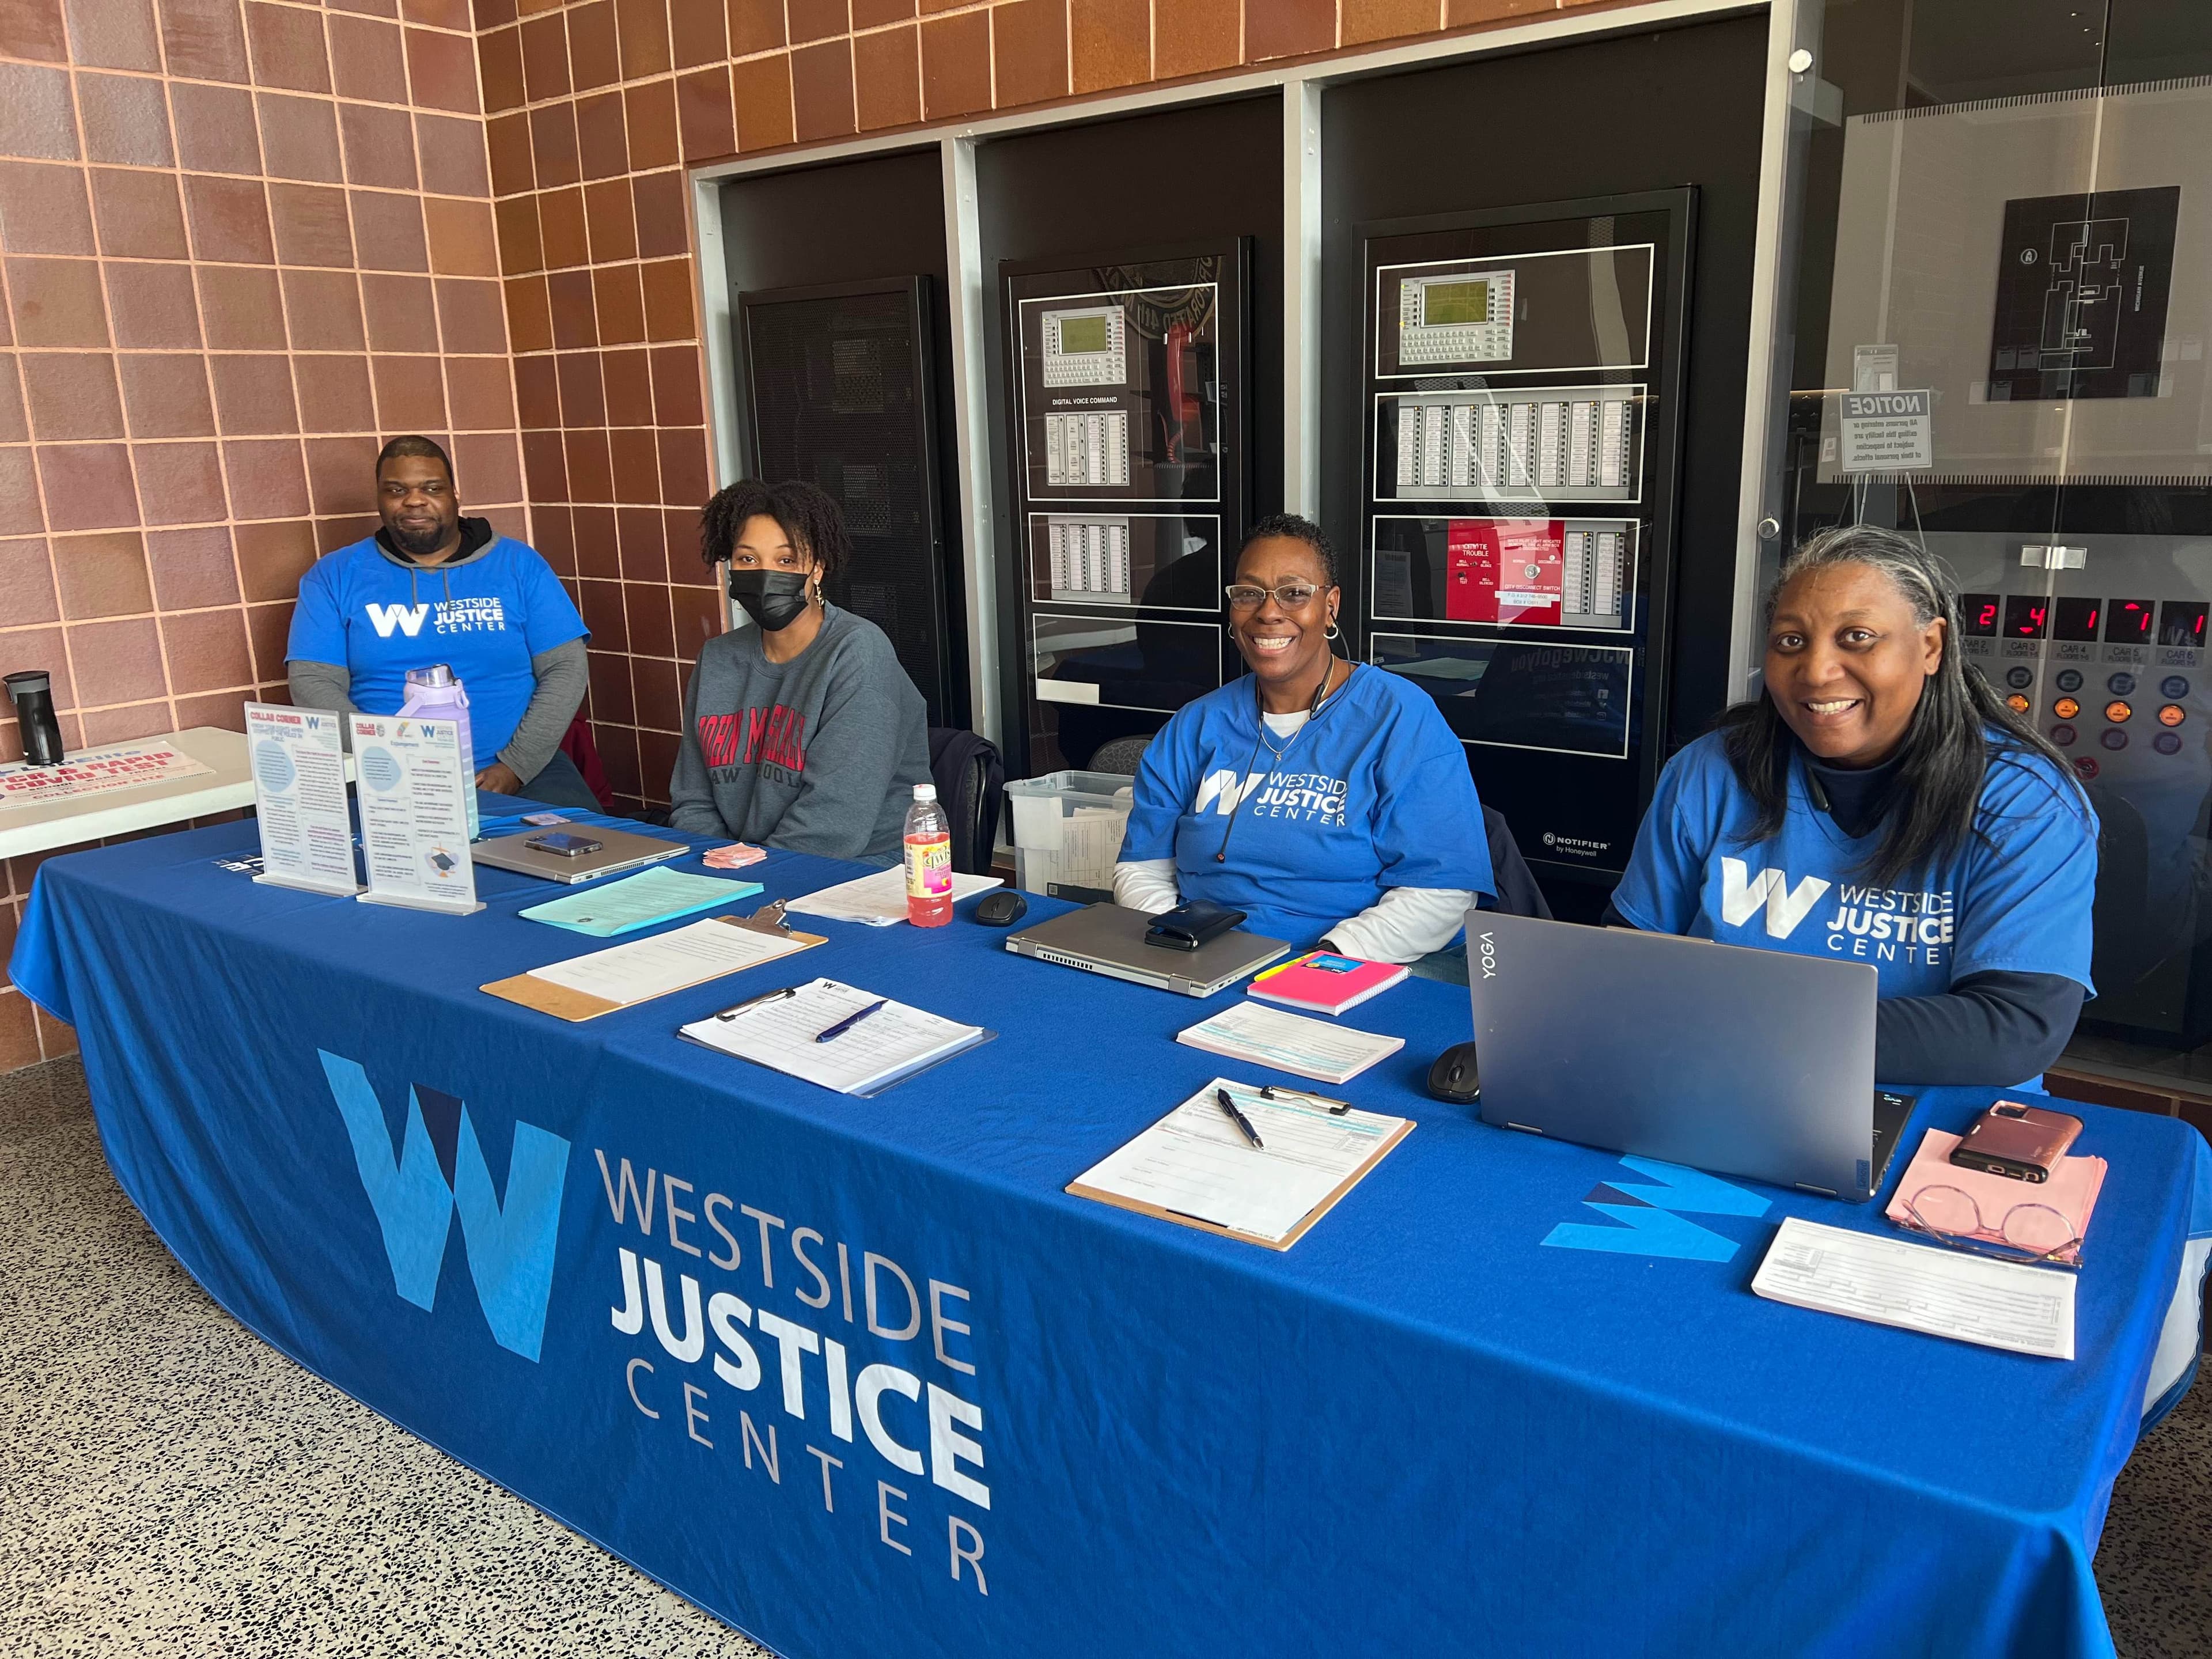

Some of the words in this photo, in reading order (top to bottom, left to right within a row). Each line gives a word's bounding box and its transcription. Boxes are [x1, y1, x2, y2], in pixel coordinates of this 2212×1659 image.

[434, 597, 502, 612] WESTSIDE
[434, 609, 503, 625] JUSTICE
[1979, 605, 1995, 626] 2
[2030, 608, 2045, 626] 4
[2088, 611, 2097, 628] 1
[2195, 615, 2203, 632] 1
[437, 622, 505, 634] CENTER
[2011, 642, 2028, 651] CAR
[2029, 642, 2036, 652] 3
[2061, 645, 2080, 653] CAR
[2113, 647, 2132, 656] CAR
[2166, 651, 2187, 660] CAR
[251, 711, 275, 722] COLLAB
[276, 714, 301, 725] CORNER
[0, 772, 48, 783] CR
[85, 752, 175, 770] RAPID
[5, 772, 96, 790] COVID
[102, 760, 168, 774] TEST
[711, 767, 742, 785] AW
[756, 764, 800, 789] OOL
[29, 782, 73, 791] SCHOOL
[128, 767, 166, 775] TRAVEL
[1270, 771, 1347, 794] WESTSID
[32, 781, 128, 799] COLLECTION
[1256, 789, 1346, 813] JUSTICE
[1254, 806, 1346, 827] CENTER
[1557, 837, 1608, 850] NOTIFIER
[1565, 847, 1597, 857] Honeywell
[1840, 884, 1953, 915] WESTSIDE
[1827, 907, 1954, 945] JUSTICE
[1479, 931, 1496, 979] YOGA
[1827, 934, 1953, 965] CENTE
[594, 1148, 976, 1376] WESTSIDE
[611, 1247, 991, 1511] JUSTICE
[626, 1358, 988, 1597] CENTER
